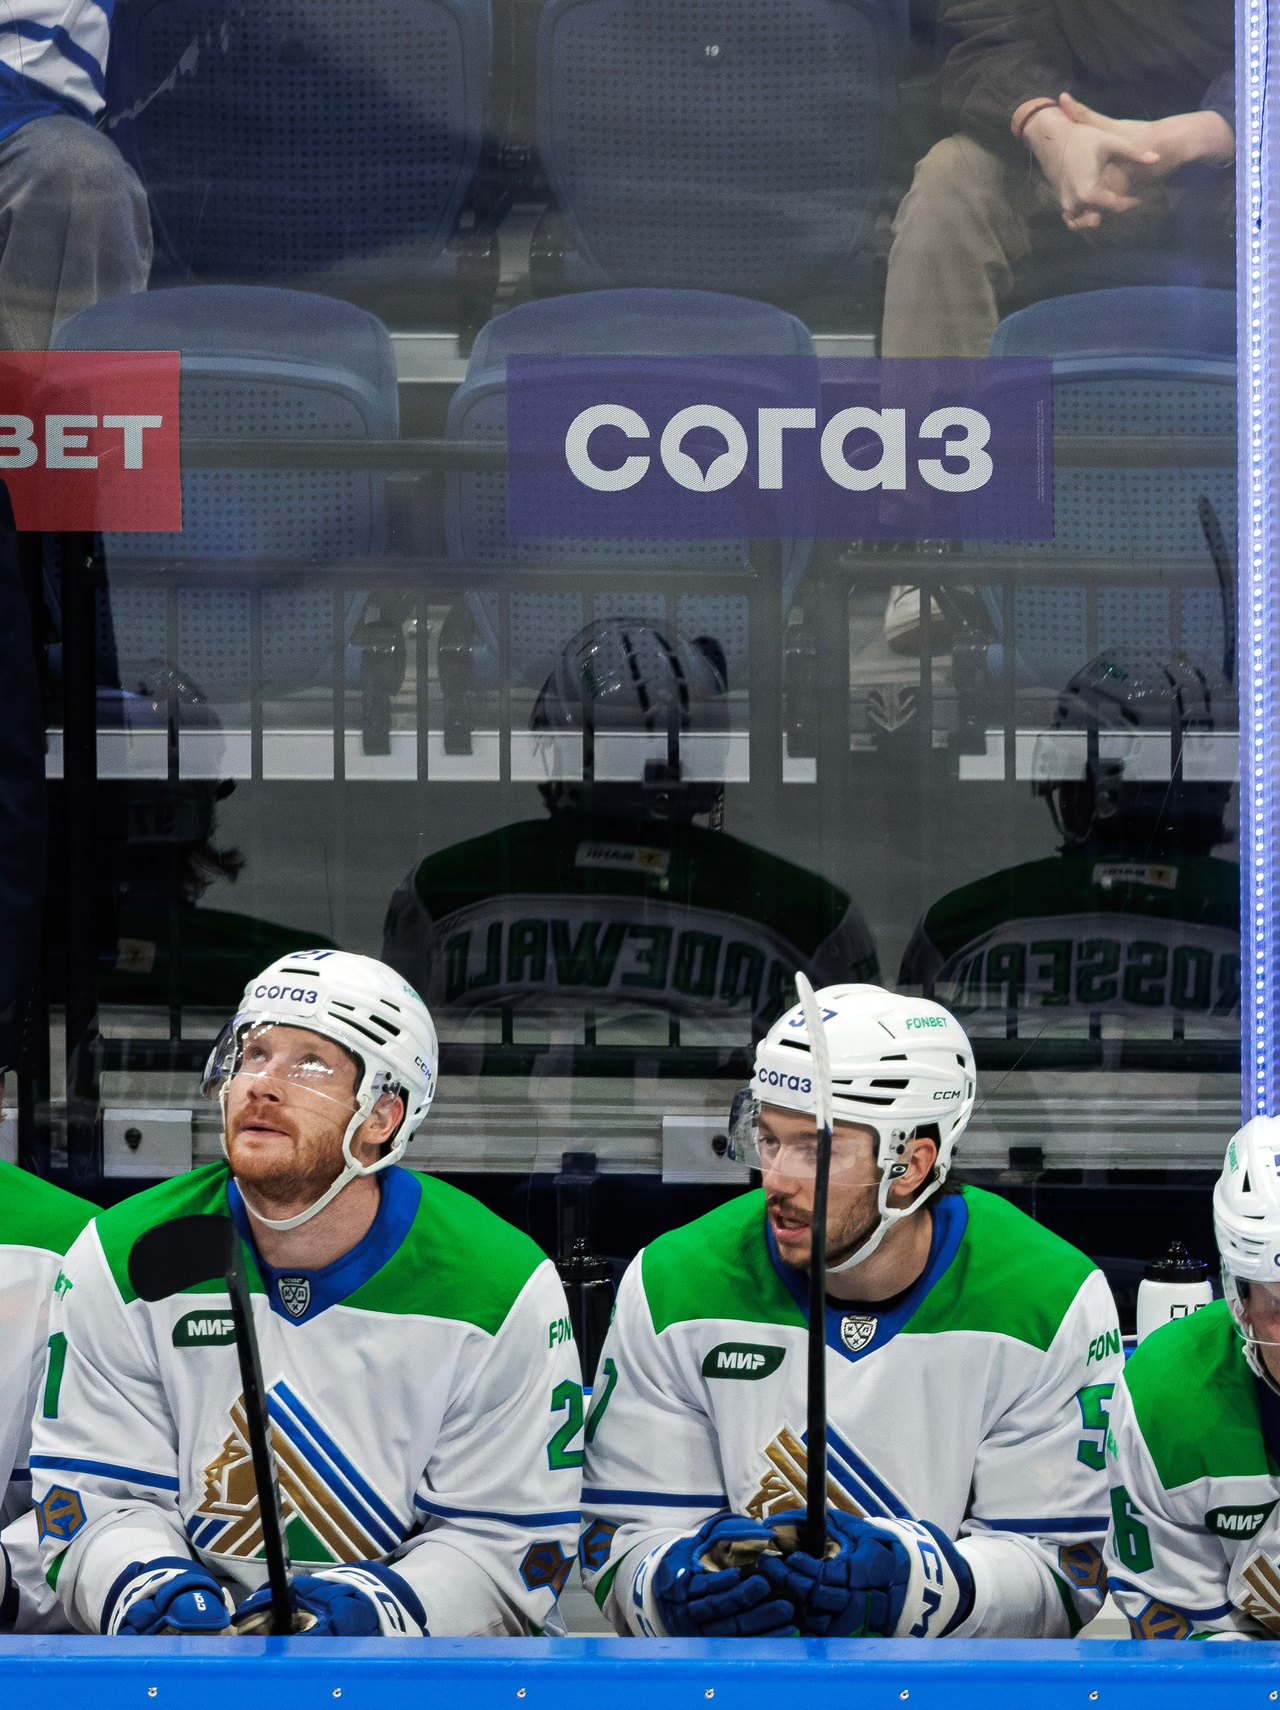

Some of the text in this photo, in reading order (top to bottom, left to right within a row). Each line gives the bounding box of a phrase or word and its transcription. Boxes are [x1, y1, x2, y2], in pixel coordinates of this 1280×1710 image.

[0, 415, 162, 469] BET
[565, 403, 993, 492] согаз
[254, 984, 318, 1004] согаз
[906, 1016, 948, 1030] FONBET
[414, 1056, 432, 1080] CCM
[758, 1067, 812, 1094] согаз
[933, 1090, 961, 1100] CCM
[187, 1319, 235, 1337] МИР
[717, 1351, 767, 1371] МИР
[547, 1379, 585, 1471] 2
[1217, 1512, 1265, 1534] МИР
